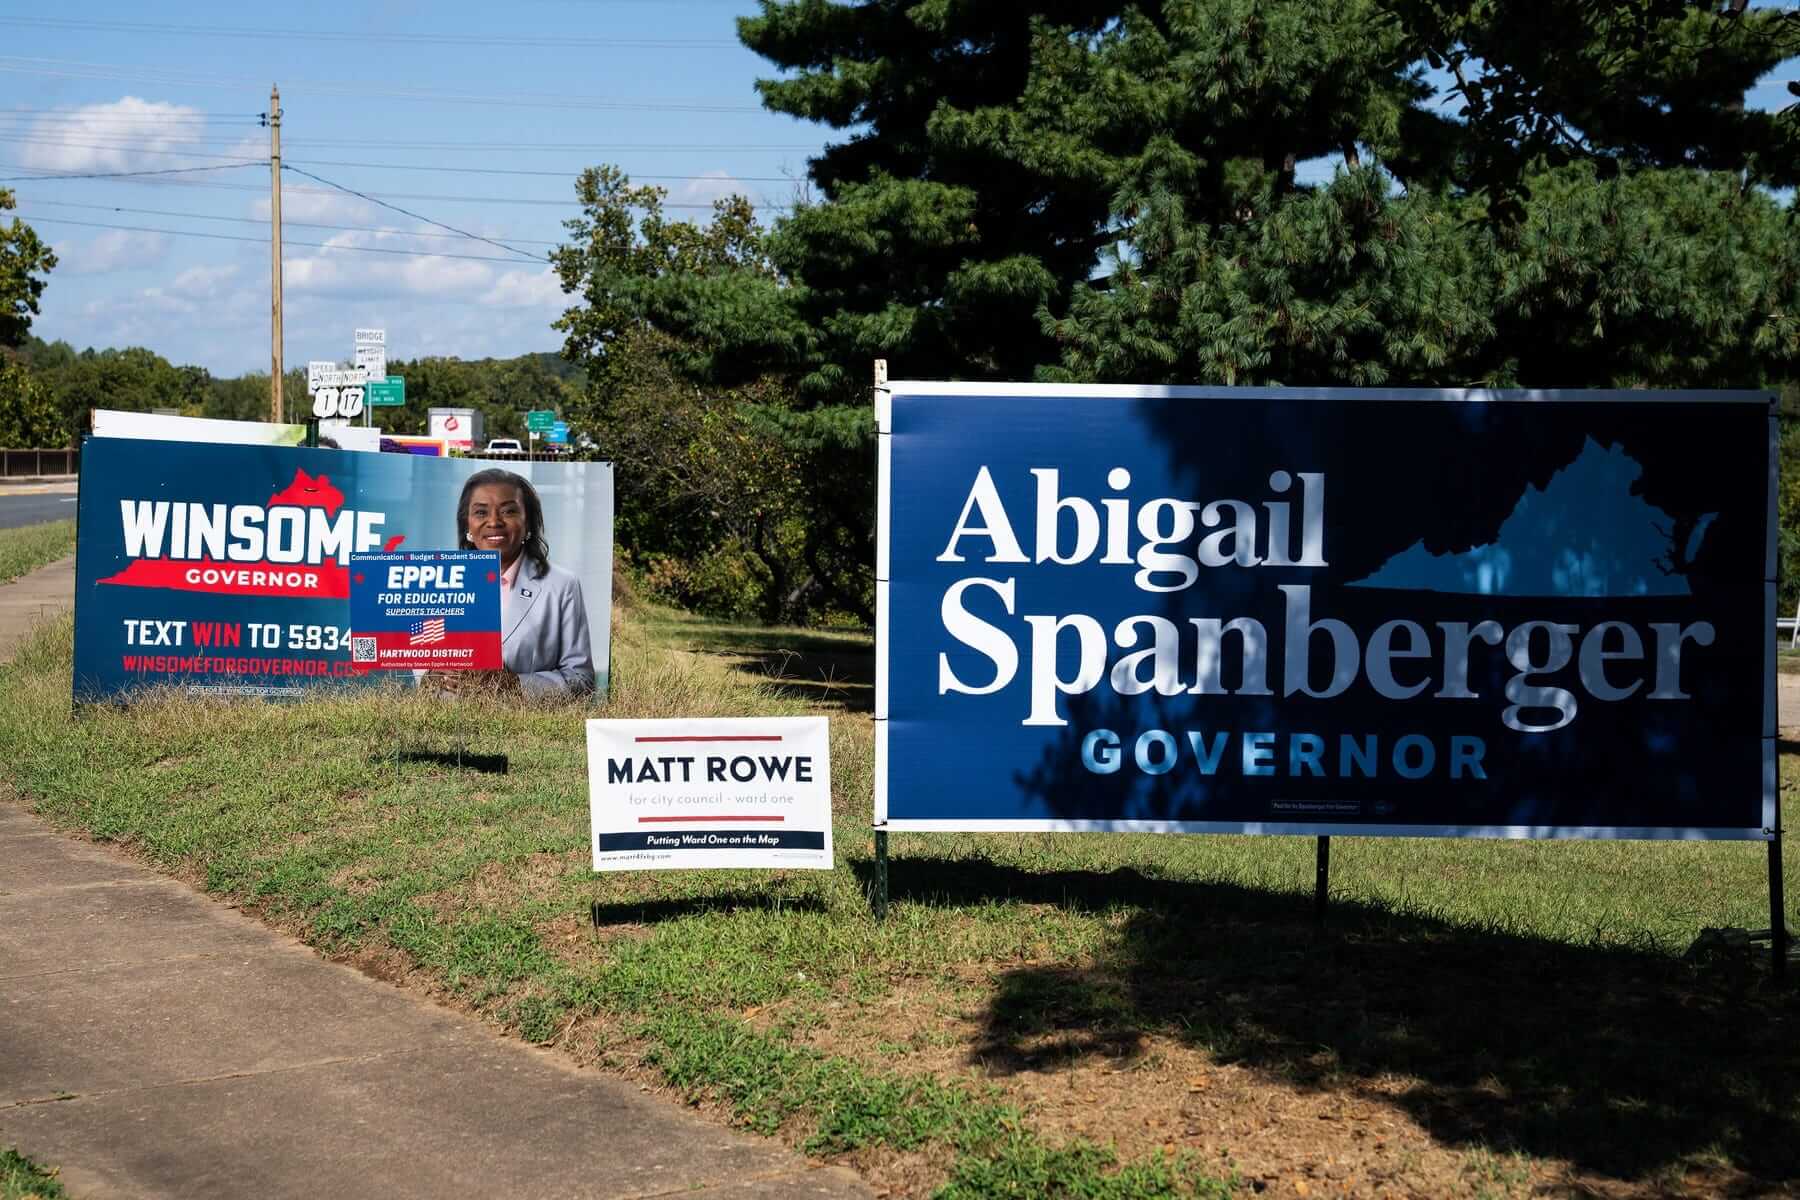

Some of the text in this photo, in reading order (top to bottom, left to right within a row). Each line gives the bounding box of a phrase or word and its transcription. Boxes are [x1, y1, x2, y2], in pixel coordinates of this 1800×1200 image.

[356, 331, 384, 340] BRIDGE
[319, 373, 341, 382] NORTH
[344, 372, 366, 383] NORTH
[324, 394, 329, 411] 1
[344, 393, 360, 411] 17
[120, 499, 386, 565] WINSOME
[936, 465, 1330, 593] Abigail
[351, 552, 497, 562] Communication Budget Student Success
[185, 568, 319, 589] GOVERNOR
[387, 565, 466, 590] EPPLE
[377, 592, 476, 605] FOR EDUCATION
[385, 607, 465, 616] SUPPORTS TEACHERS
[123, 619, 187, 646] TEXT
[191, 621, 241, 648] WIN
[247, 623, 281, 649] TO
[379, 649, 474, 658] HARTWOOD DISTRICT
[937, 577, 1716, 733] Spanberger
[1081, 729, 1489, 780] GOVERNOR
[607, 755, 813, 784] MATT ROWE
[629, 792, 794, 808] for city council ward one
[647, 834, 780, 847] Putting Ward One on the Map
